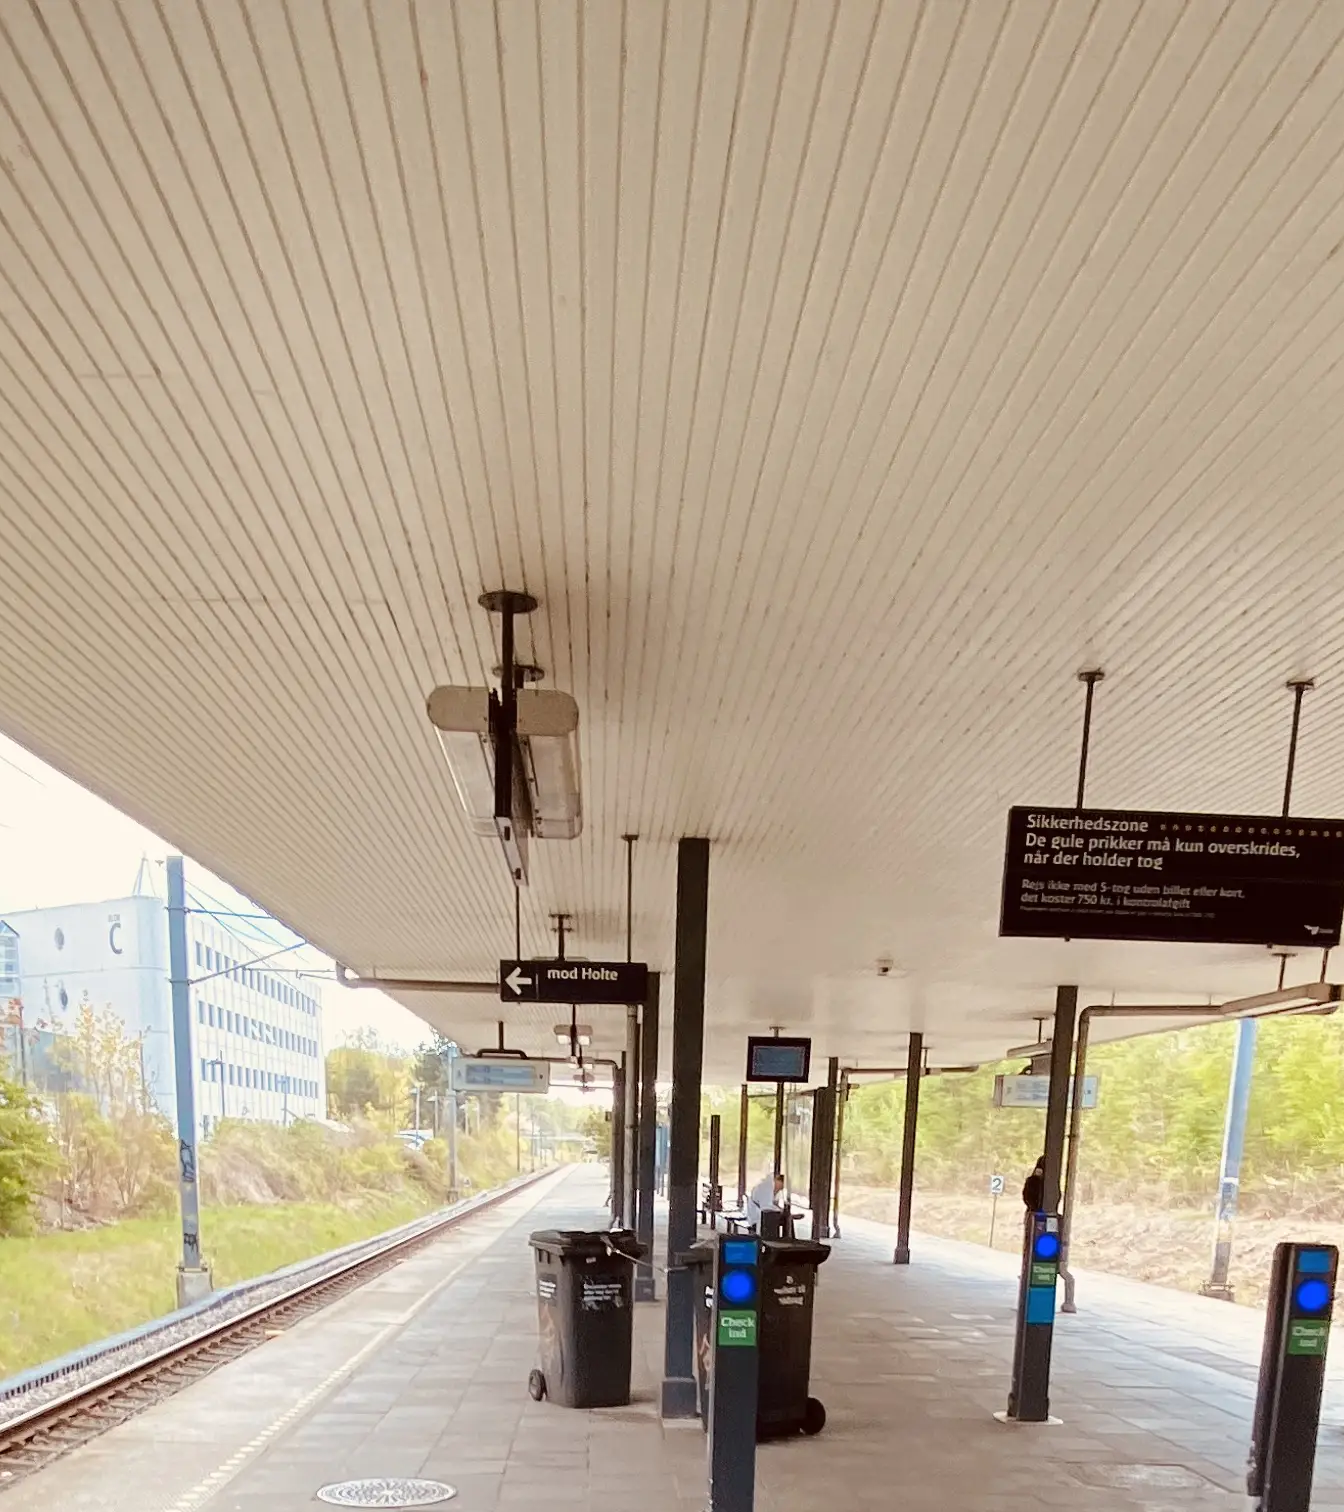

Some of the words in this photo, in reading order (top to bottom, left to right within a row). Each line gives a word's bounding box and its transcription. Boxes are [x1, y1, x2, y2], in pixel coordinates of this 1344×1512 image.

[1027, 814, 1148, 832] Sikkerhedszone
[1025, 832, 1046, 847] De
[1051, 834, 1084, 850] gule
[1088, 835, 1144, 851] prikker
[1147, 836, 1170, 851] må
[1175, 838, 1203, 852] kun
[1208, 841, 1300, 858] overskrides,
[1023, 850, 1050, 864] når
[1052, 850, 1079, 865] der
[1083, 852, 1133, 867] holder
[1137, 856, 1163, 870] tog
[1021, 878, 1045, 891] Rejs
[1073, 881, 1097, 892] med
[1133, 884, 1160, 894] uden
[1163, 885, 1191, 896] billet
[1193, 886, 1218, 897] eller
[1041, 893, 1076, 904] koster
[1077, 894, 1098, 905] 750
[109, 922, 122, 954] C
[547, 967, 578, 980] mod
[582, 968, 618, 981] Holte
[992, 1177, 1002, 1191] 2
[720, 1317, 755, 1328] Check
